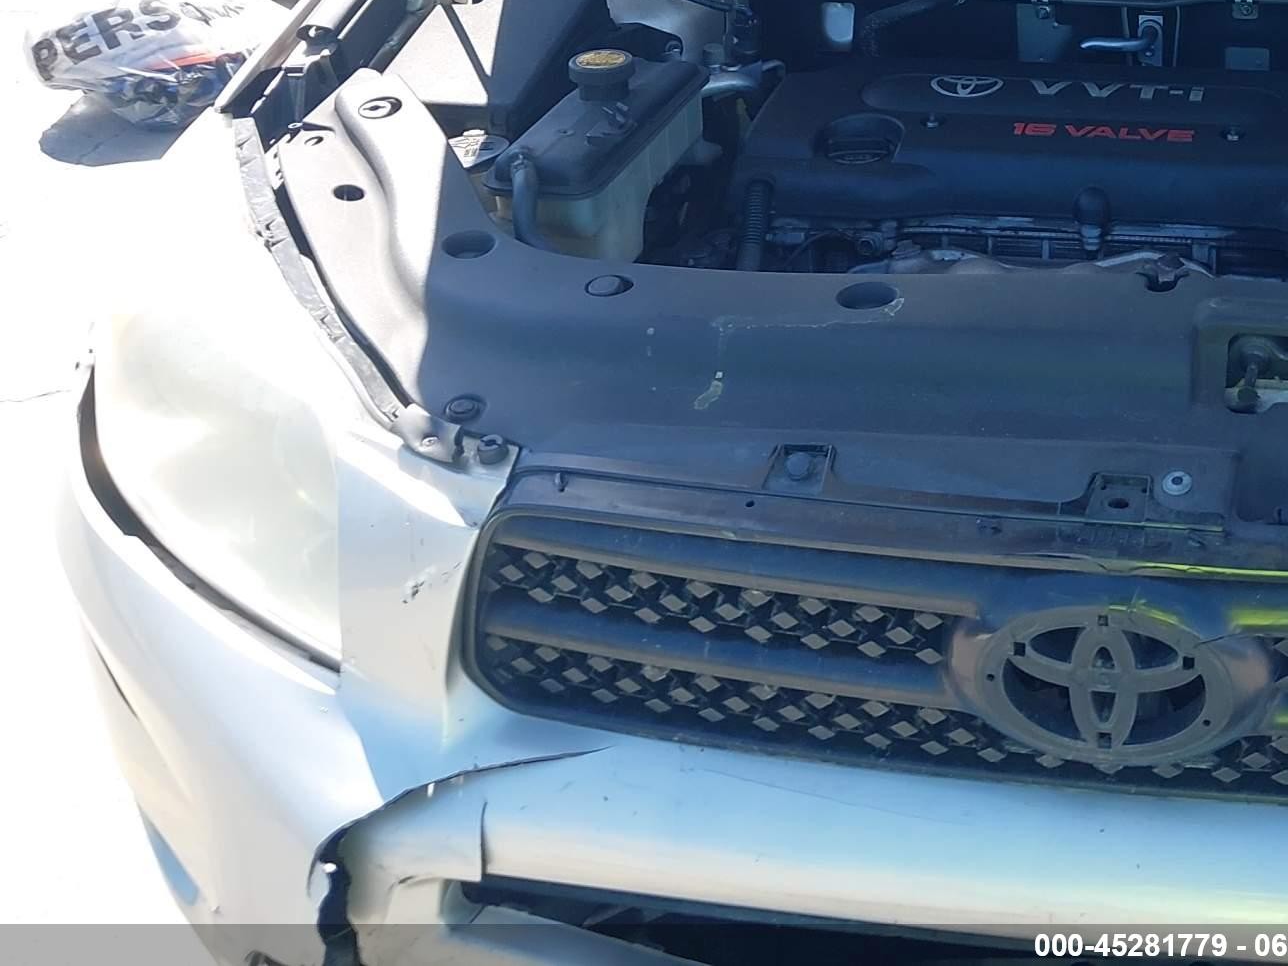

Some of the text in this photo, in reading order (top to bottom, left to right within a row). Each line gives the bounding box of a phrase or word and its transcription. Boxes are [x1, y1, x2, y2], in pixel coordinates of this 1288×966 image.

[1030, 78, 1205, 102] VVT-i
[1013, 121, 1195, 142] 16 VALVE
